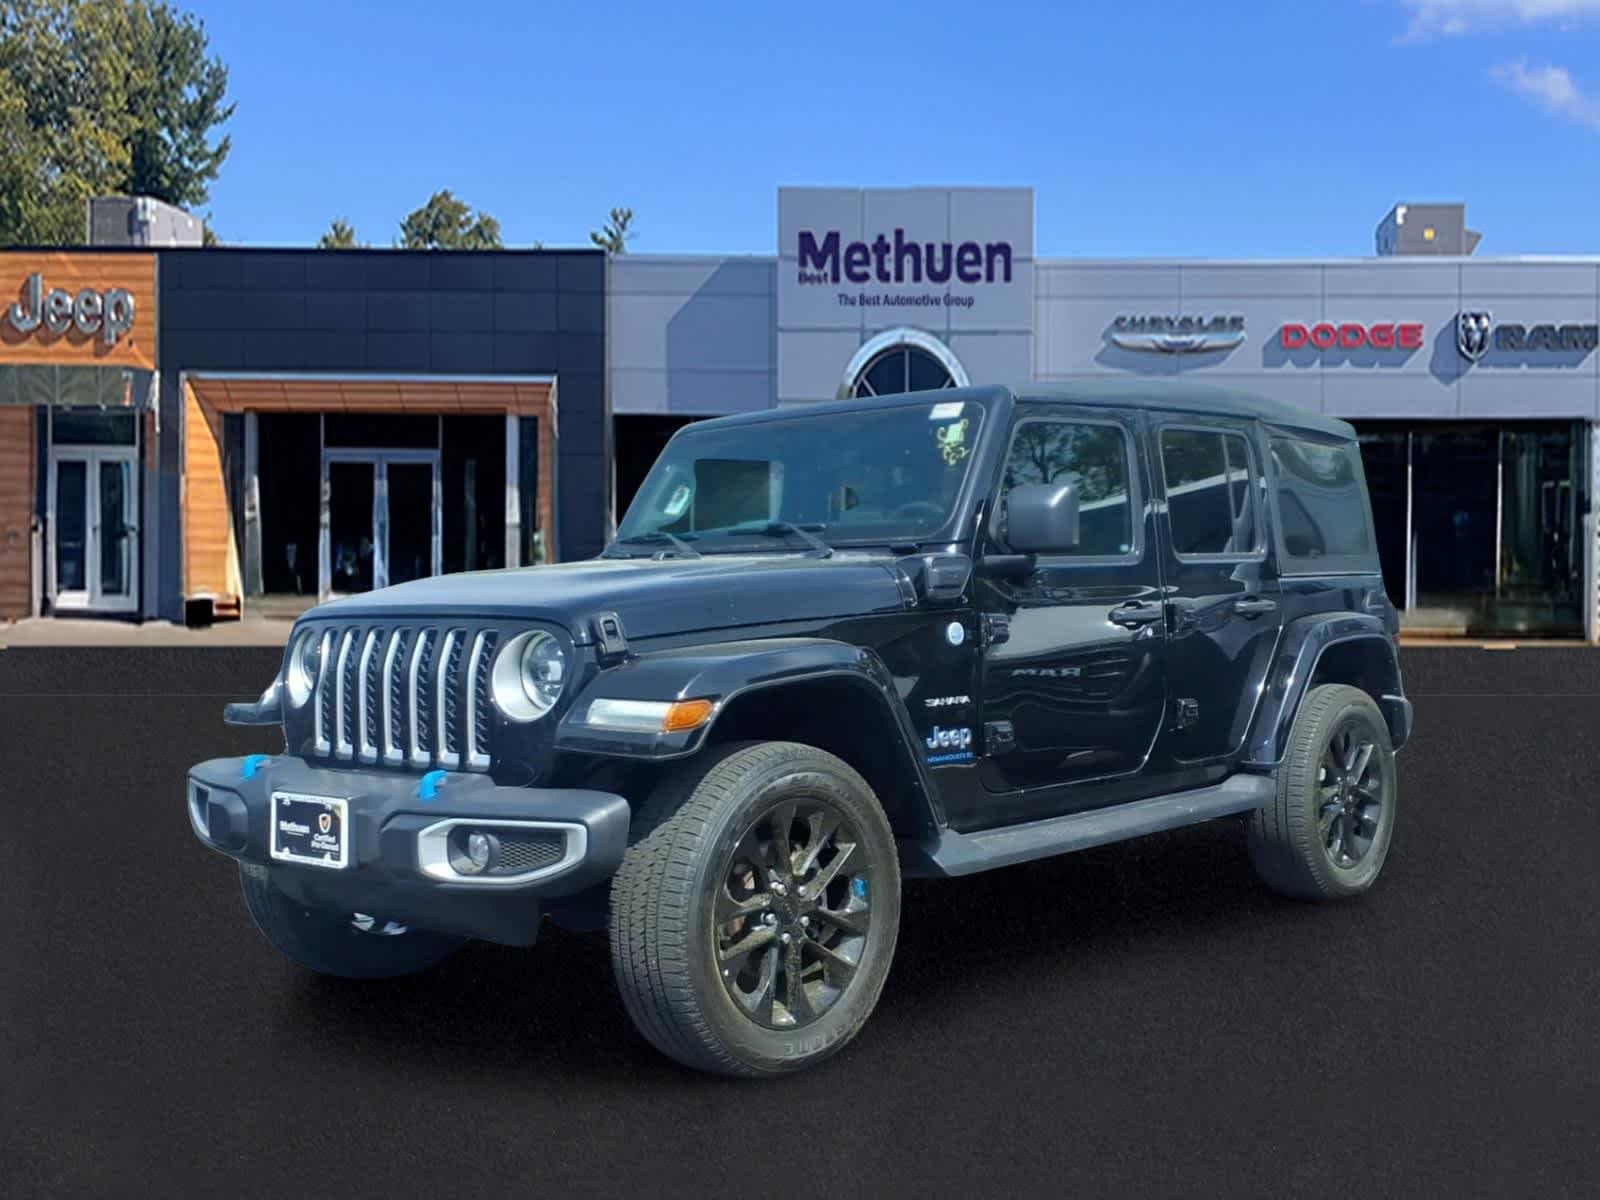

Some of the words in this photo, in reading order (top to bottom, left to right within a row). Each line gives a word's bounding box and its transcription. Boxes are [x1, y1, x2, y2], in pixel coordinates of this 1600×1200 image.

[798, 228, 1012, 284] Methuen
[799, 270, 829, 285] Best
[9, 272, 135, 345] Jeep
[837, 293, 856, 307] The
[859, 293, 881, 307] Best
[883, 293, 941, 307] Automotive
[943, 293, 974, 309] Group
[1281, 322, 1424, 350] DODGE
[1494, 323, 1599, 352] RAM
[926, 725, 972, 750] Jeep
